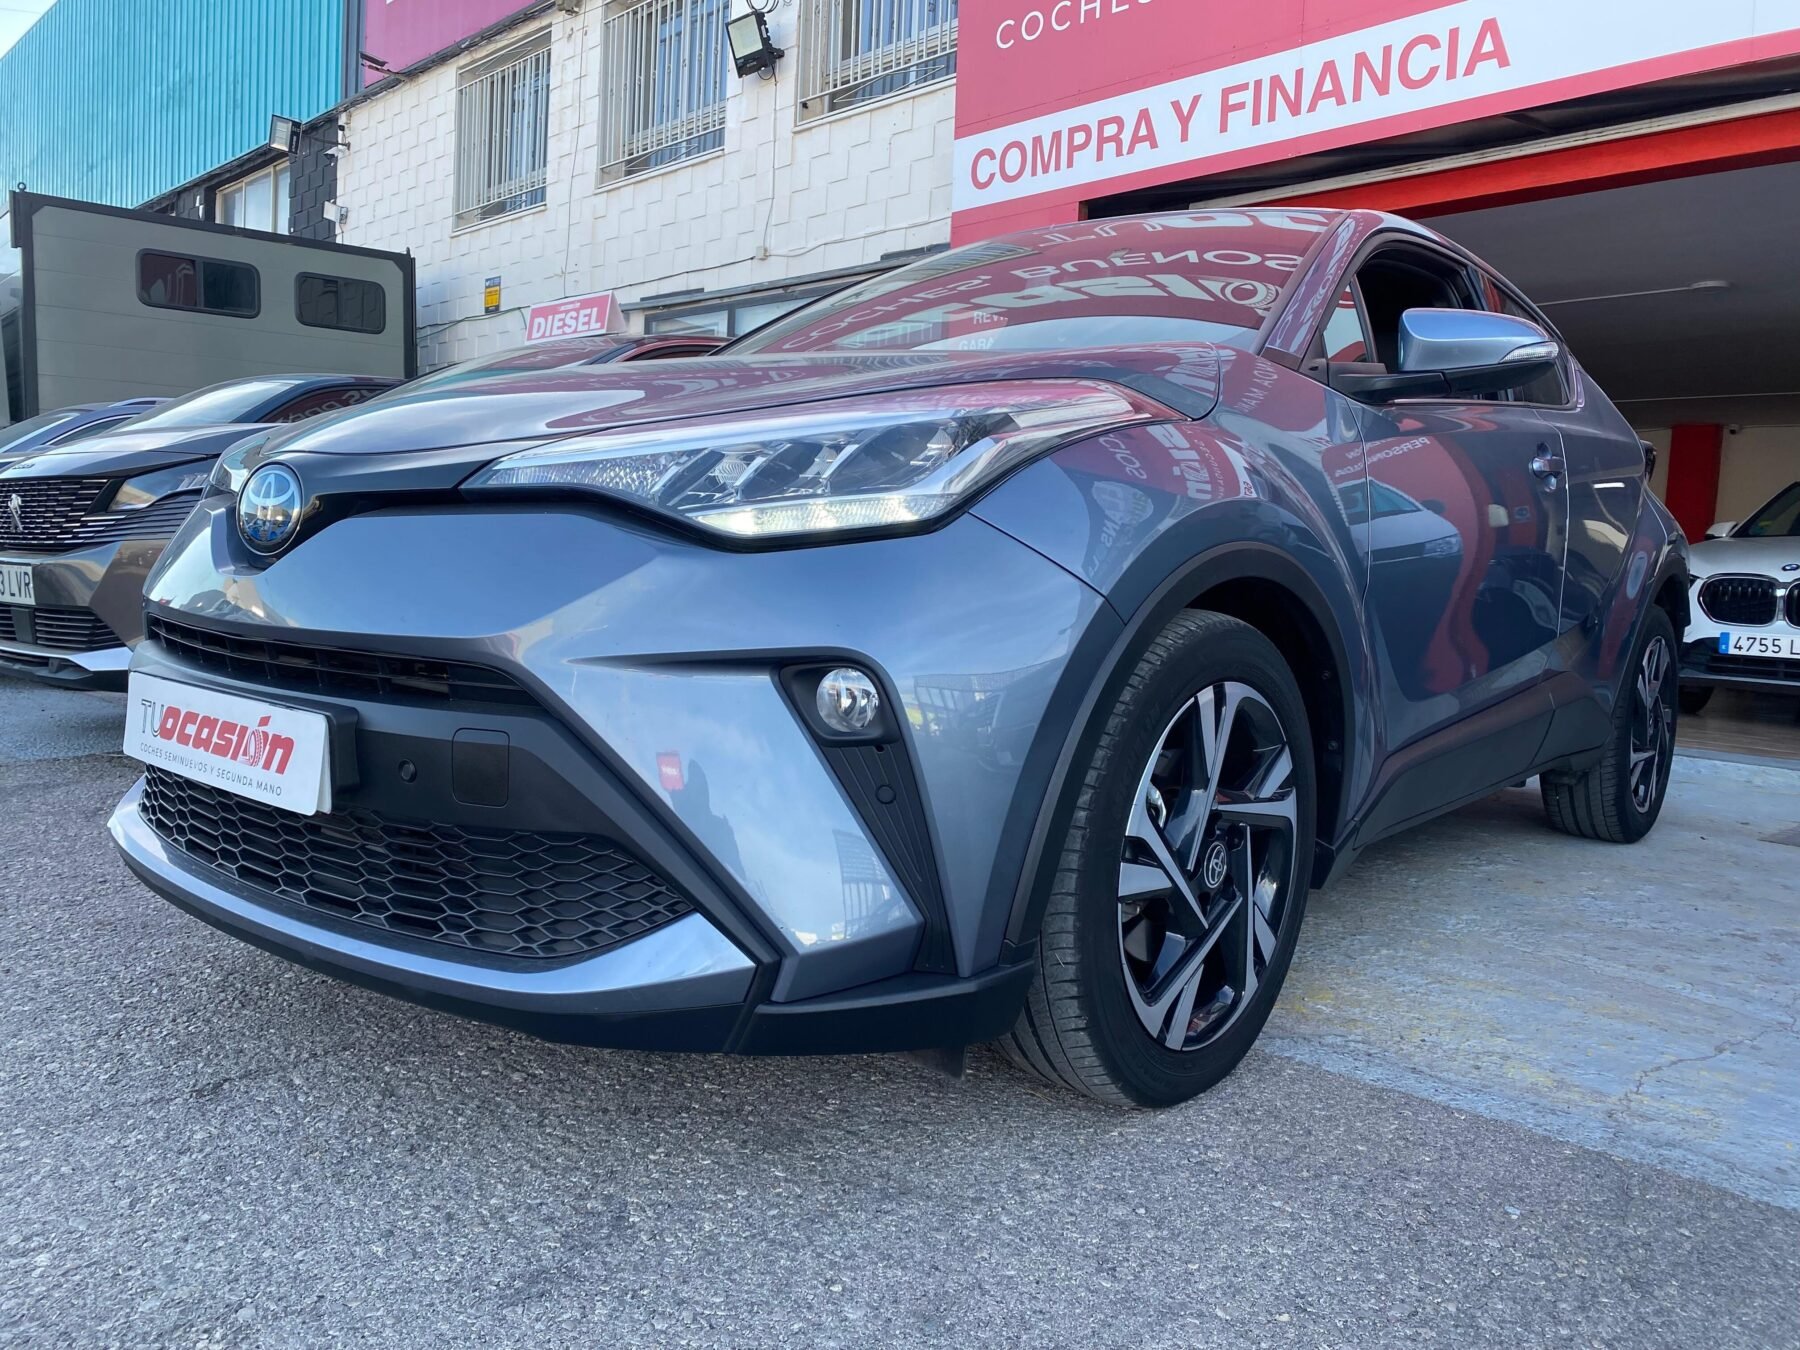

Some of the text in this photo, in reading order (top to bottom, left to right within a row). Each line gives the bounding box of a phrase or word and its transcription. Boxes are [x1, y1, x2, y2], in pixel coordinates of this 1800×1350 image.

[996, 0, 1151, 49] COCH
[969, 17, 1512, 191] COMPRA Y FINANCIA
[531, 306, 601, 340] DIESEL
[8, 570, 32, 599] LVR
[1733, 636, 1782, 654] 4755
[140, 742, 283, 797] COCHES SEMINUEVOS Y SEGUNDA MANO
